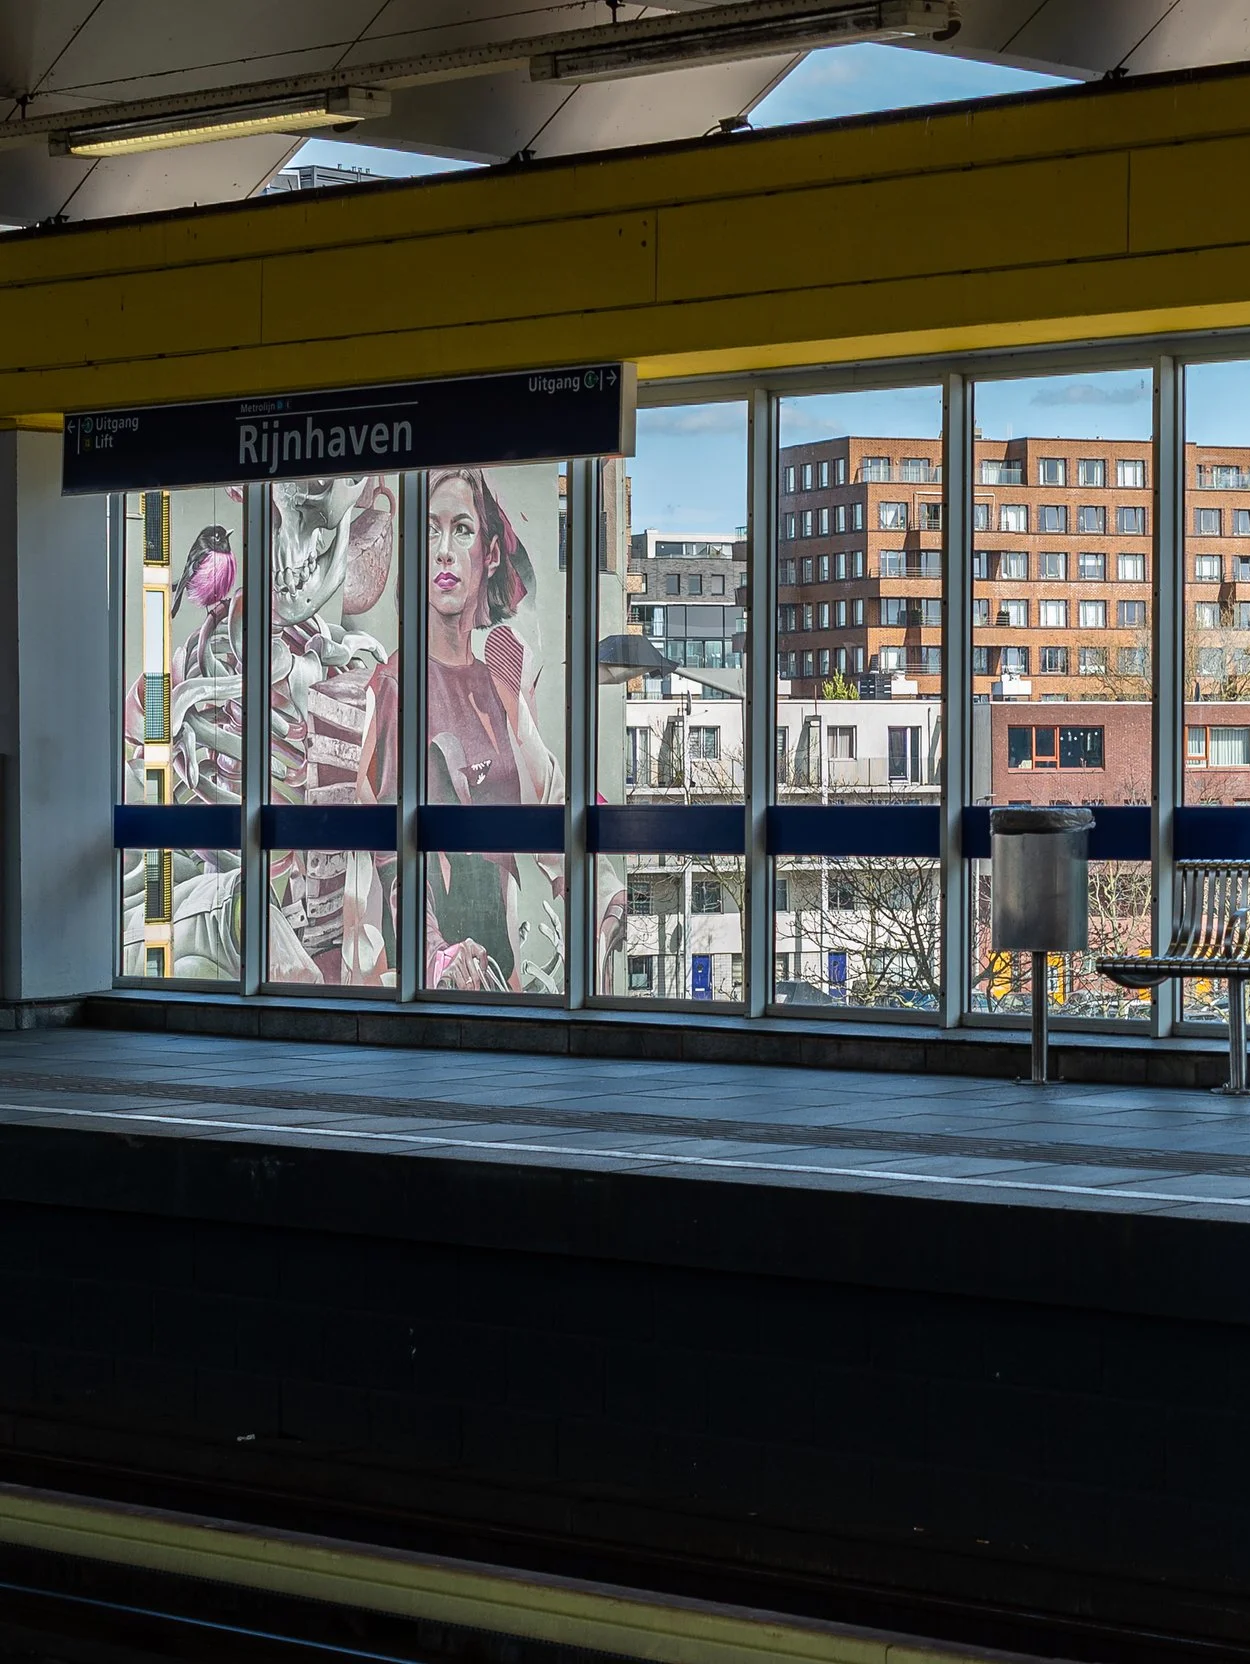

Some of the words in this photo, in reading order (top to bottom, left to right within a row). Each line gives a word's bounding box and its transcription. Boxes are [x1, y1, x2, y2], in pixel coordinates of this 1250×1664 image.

[528, 375, 581, 394] Uitgang
[240, 401, 275, 413] Metrolijn
[95, 415, 139, 432] Uitgang
[95, 433, 115, 449] Lift
[238, 415, 413, 475] Rijnhaven
